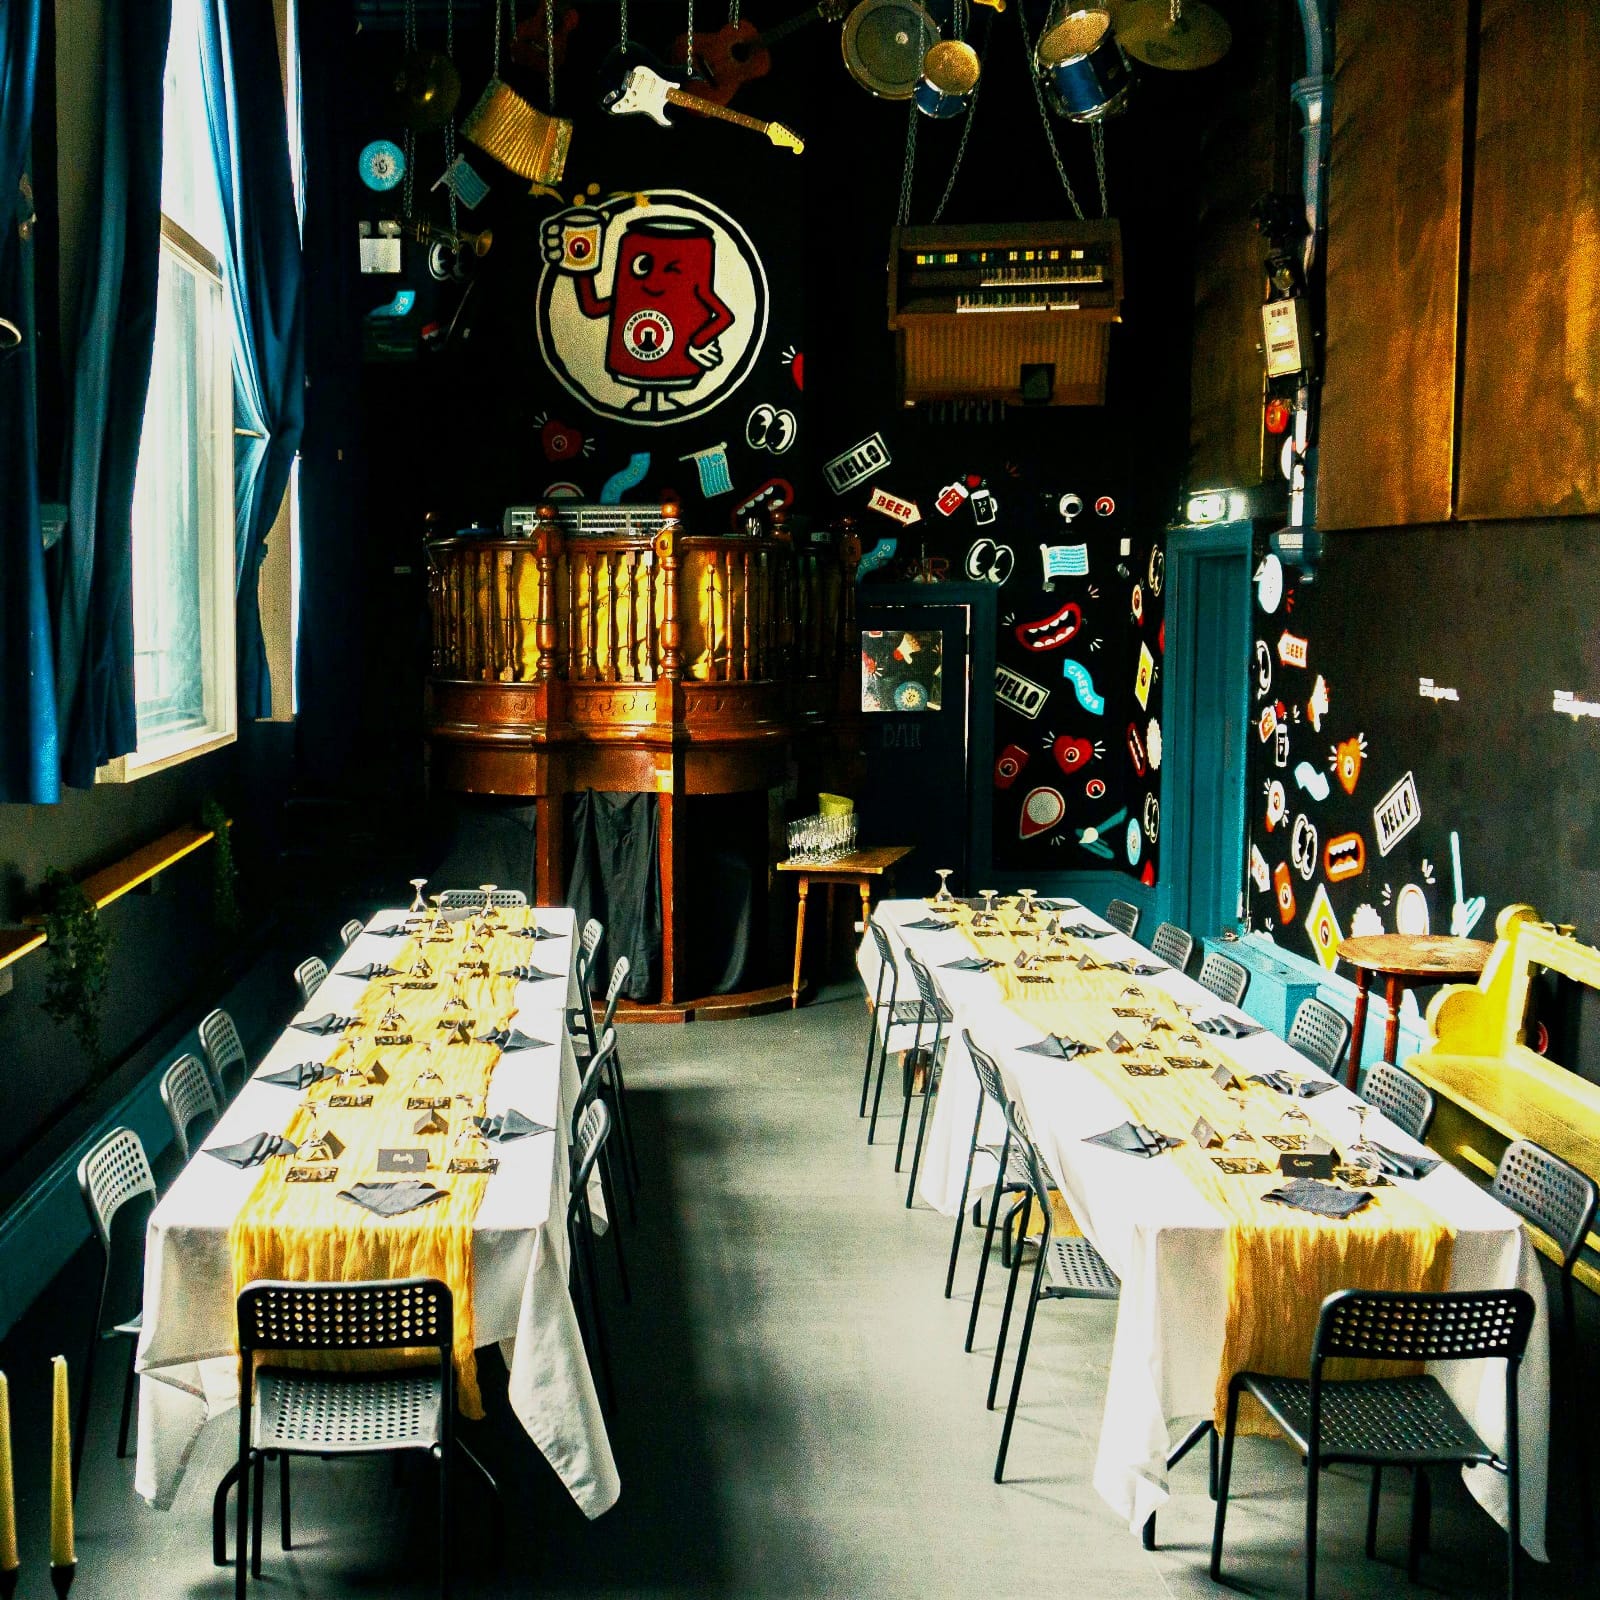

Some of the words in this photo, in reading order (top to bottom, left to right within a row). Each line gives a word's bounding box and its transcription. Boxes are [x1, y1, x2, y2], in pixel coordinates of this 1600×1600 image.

[626, 312, 653, 332] CAMDEN
[655, 313, 670, 332] TOWN
[631, 346, 665, 359] BREWERY
[832, 445, 882, 485] HELLO
[876, 494, 913, 519] BEER
[1381, 790, 1411, 841] HELLO
